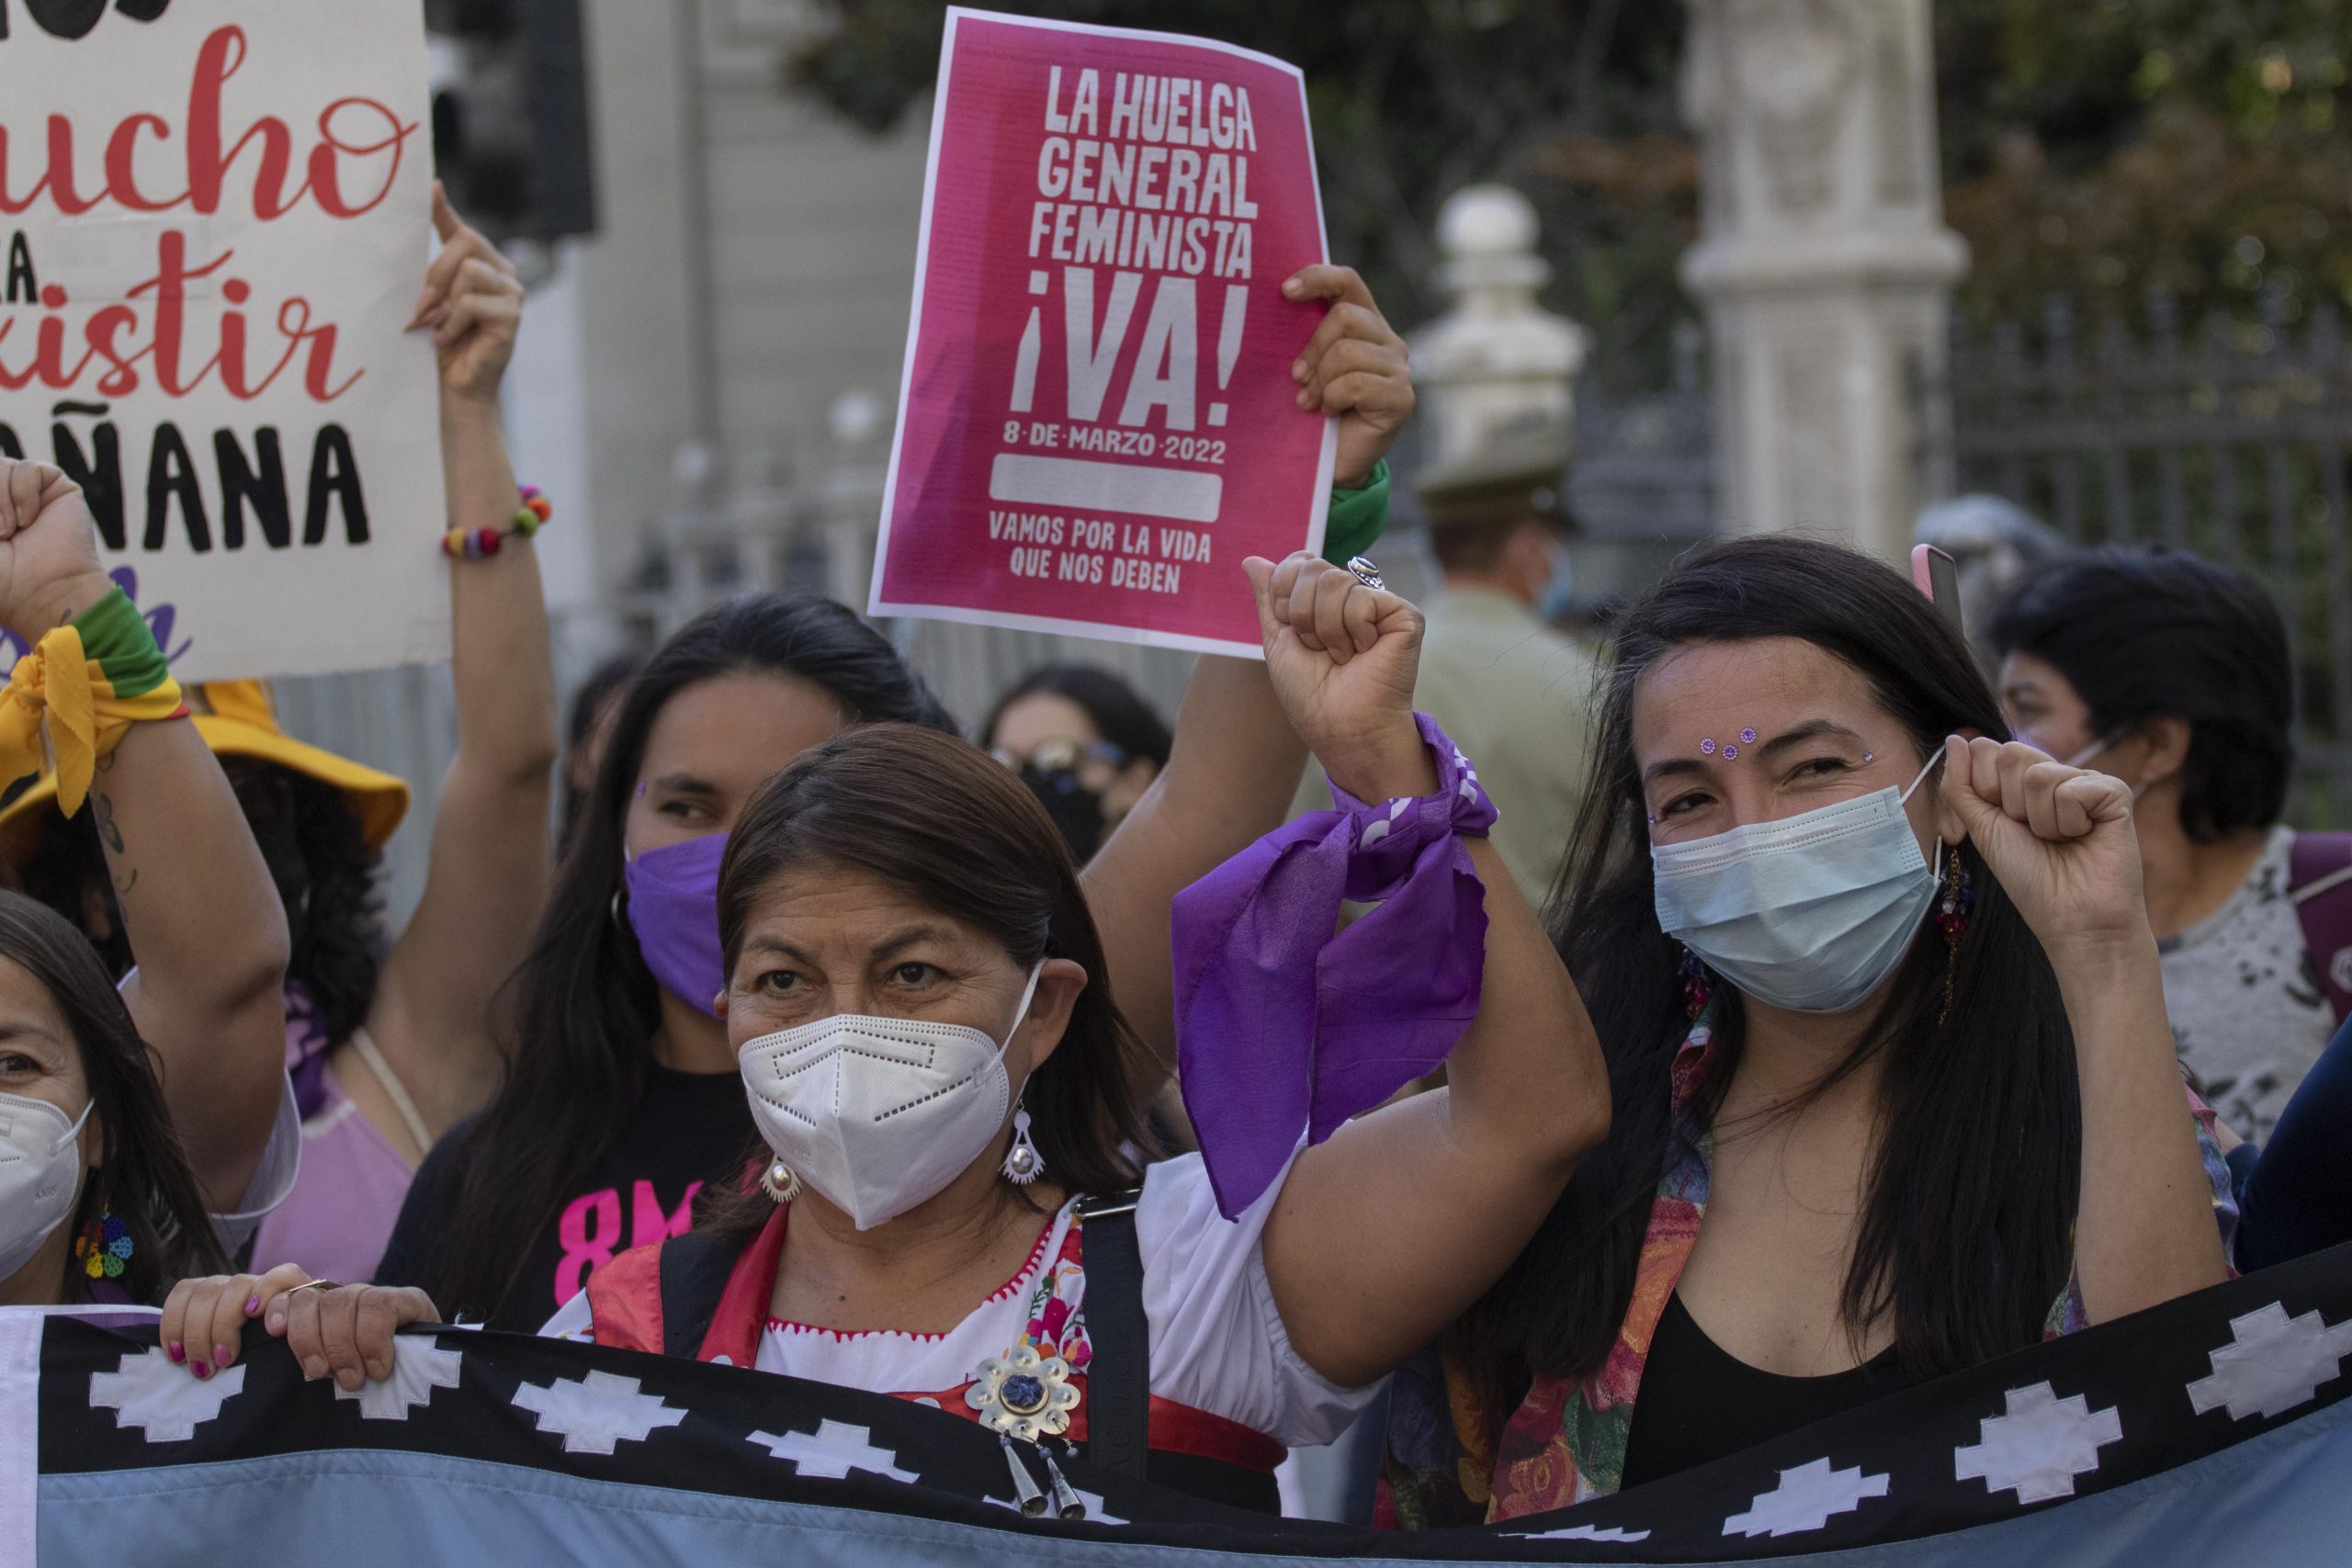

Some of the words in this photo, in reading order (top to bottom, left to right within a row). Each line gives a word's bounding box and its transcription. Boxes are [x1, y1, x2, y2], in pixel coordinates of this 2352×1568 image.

[1045, 65, 1100, 136] LA
[1109, 73, 1257, 152] HUELGA
[1037, 136, 1258, 220] GENERAL
[0, 229, 39, 305] A
[1028, 201, 1252, 279] FEMINISTA
[1010, 265, 1250, 432] ¡VA!
[0, 400, 371, 554] ÑANA
[989, 511, 1065, 546] VAMOS
[1070, 518, 1115, 551] POR
[1122, 524, 1149, 555] LA
[1160, 528, 1212, 563] VIDA
[1010, 547, 1052, 578] QUE
[1058, 552, 1103, 584] NOS
[1110, 557, 1182, 593] DEBEN
